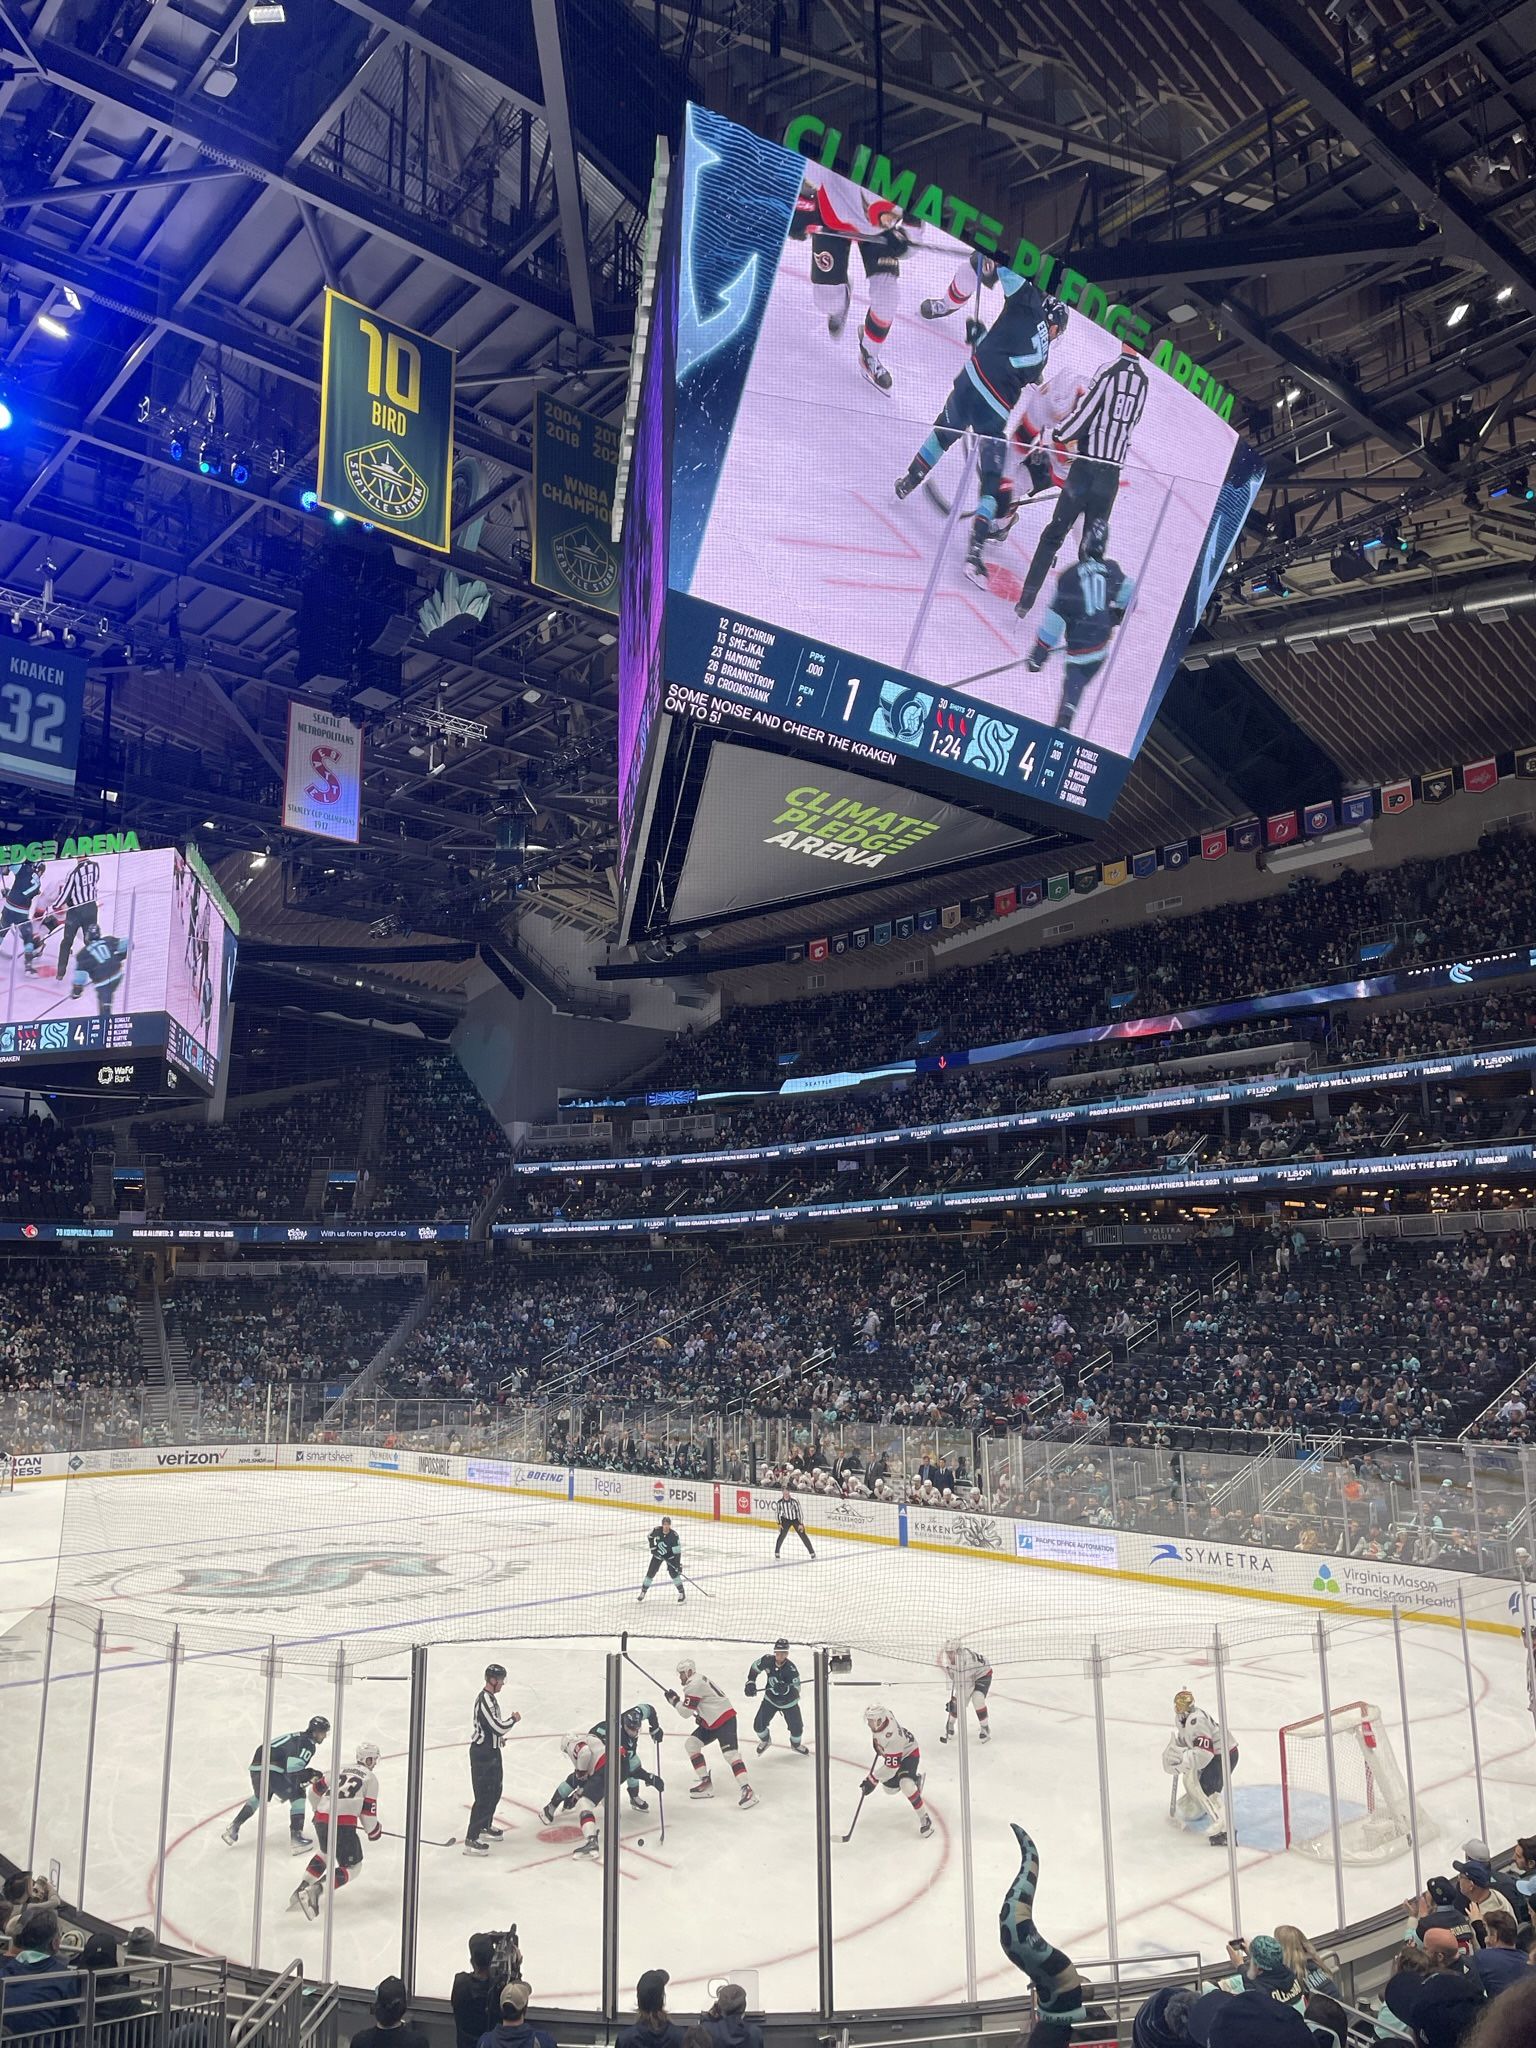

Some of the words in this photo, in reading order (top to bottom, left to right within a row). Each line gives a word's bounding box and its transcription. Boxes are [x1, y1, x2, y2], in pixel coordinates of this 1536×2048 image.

[783, 114, 1004, 253] CLIMATE
[1012, 238, 1151, 347] PLEDGE
[1154, 339, 1235, 423] ARENA
[359, 319, 421, 414] 10
[1112, 391, 1135, 422] 80
[372, 401, 406, 437] BIRD
[544, 402, 581, 430] 2004
[595, 426, 619, 448] 201
[546, 421, 579, 448] 2018
[593, 444, 619, 465] 202
[349, 461, 388, 513] SEATTLE
[395, 487, 424, 514] STORM
[564, 474, 608, 506] WNBA
[542, 483, 612, 522] CHAMPIO
[556, 544, 590, 590] SEATTLE
[593, 565, 618, 592] STORM
[1079, 559, 1108, 616] 10
[719, 618, 729, 630] 12
[733, 622, 776, 646] CHYCHRUN
[718, 632, 726, 644] 13
[729, 636, 765, 658] SMEJKAL
[711, 646, 722, 658] 23
[724, 650, 762, 671] HAMONIC
[809, 652, 826, 663] PP%
[10, 657, 64, 686] KRAKEN
[707, 659, 718, 672] 26
[721, 663, 775, 690] BRANNSTROM
[806, 663, 824, 677] .000
[704, 673, 715, 685] 59
[717, 678, 770, 703] CROOKSHANK
[799, 685, 814, 696] PEN
[796, 696, 803, 707] 2
[842, 678, 861, 722] 1
[938, 698, 948, 709] 30
[966, 708, 976, 719] 27
[0, 683, 66, 753] 32
[313, 712, 340, 729] SEATTLE
[665, 697, 685, 713] ON
[689, 704, 708, 720] TO
[709, 712, 722, 725] 5!
[298, 722, 354, 746] METROPOLITANS
[668, 683, 709, 707] SOME
[711, 698, 752, 720] NOISE
[753, 710, 780, 730] AND
[782, 718, 824, 744] CHEER
[827, 732, 850, 751] THE
[851, 740, 897, 766] KRAKEN
[929, 730, 961, 760] 1:24
[1018, 741, 1036, 781] 4
[288, 804, 310, 816] STANLEY
[784, 786, 940, 836] CLIMATE
[314, 820, 328, 830] 1917
[772, 808, 914, 855] PLEDGE
[0, 840, 58, 865] EDGE
[60, 830, 140, 859] ARENA
[763, 830, 887, 868] ARENA
[82, 875, 93, 886] 80
[86, 940, 112, 964] 10
[18, 1039, 37, 1051] 1:24
[74, 1025, 84, 1045] 4
[114, 1066, 134, 1075] WaFd
[1473, 1056, 1513, 1067] FILSON
[114, 1075, 130, 1083] Bank
[1296, 1082, 1318, 1090] MIGHT
[1330, 1078, 1350, 1087] WELL
[1351, 1076, 1370, 1084] HAVE
[1371, 1074, 1387, 1082] THE
[1388, 1071, 1408, 1080] BEST
[1247, 1086, 1278, 1095] FILSON
[1050, 1112, 1075, 1120] FILSON
[1089, 1108, 1108, 1116] PROUD
[1109, 1105, 1132, 1114] KRAKEN
[1132, 1102, 1163, 1111] PARTNERS
[1277, 1170, 1312, 1178] FILSON
[1371, 1165, 1393, 1173] WELL
[1394, 1163, 1416, 1172] HAVE
[1436, 1160, 1458, 1168] BEST
[1061, 1187, 1088, 1195] FILSON
[1125, 1184, 1150, 1192] KRAKEN
[1151, 1182, 1184, 1190] PARTNERS
[374, 1230, 396, 1238] ground
[157, 1450, 220, 1465] verizon
[306, 1451, 353, 1463] smartsheet
[418, 1456, 450, 1476] IMPOSSIBLE
[527, 1471, 564, 1483] BOEING
[594, 1478, 621, 1496] Tegria
[669, 1488, 697, 1502] PEPSI
[754, 1499, 778, 1510] TOYO
[915, 1521, 950, 1534] KRAKEN
[1077, 1542, 1114, 1552] AUTOMATION
[1185, 1547, 1273, 1572] SYMETRA
[1344, 1568, 1390, 1584] Virginia
[1393, 1574, 1437, 1592] Mason
[1345, 1583, 1412, 1604] Franciscan
[1416, 1595, 1456, 1608] Health
[1197, 1737, 1210, 1748] 70
[299, 1747, 312, 1762] 10
[885, 1756, 898, 1766] 26
[371, 1802, 376, 1813] 2
